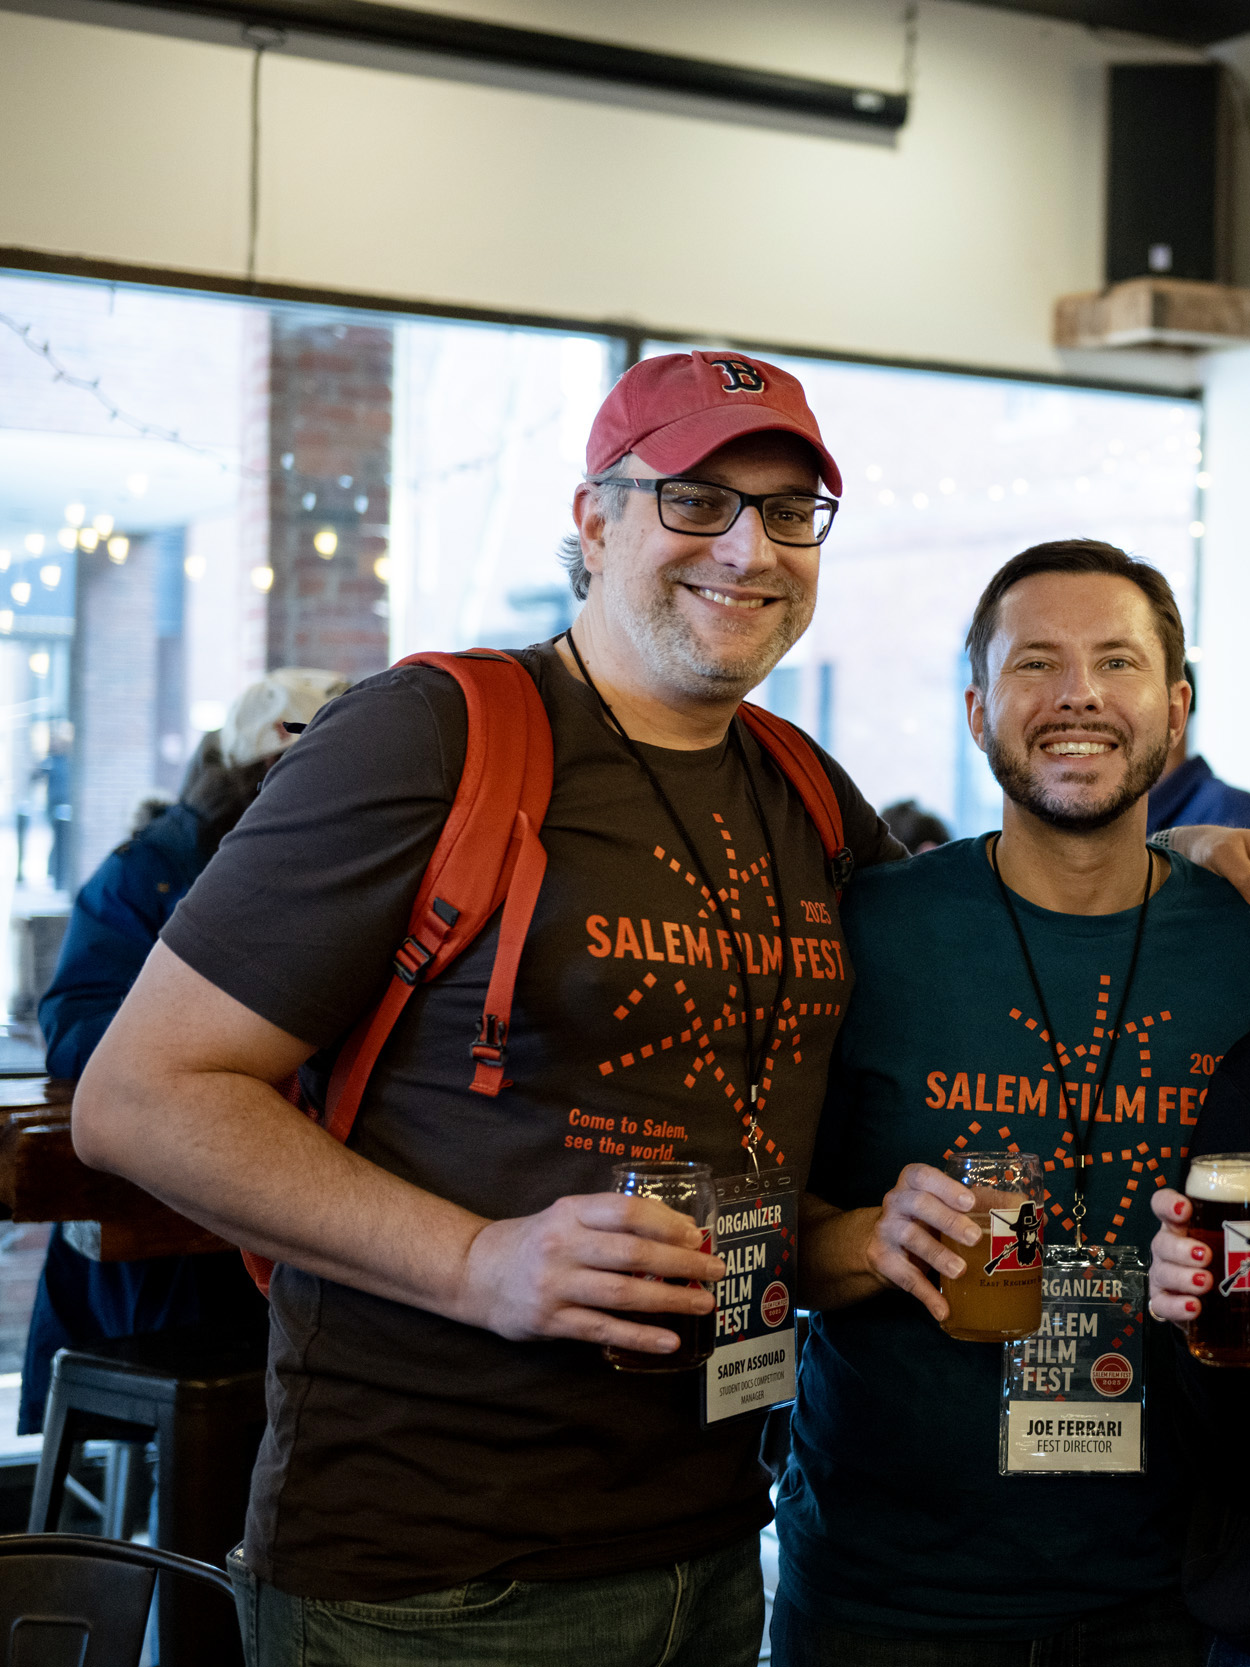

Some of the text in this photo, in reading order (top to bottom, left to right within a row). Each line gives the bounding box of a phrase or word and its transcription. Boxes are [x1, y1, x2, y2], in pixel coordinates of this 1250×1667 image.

[711, 359, 764, 393] B
[800, 900, 832, 925] 2025
[585, 914, 713, 969] SALEM
[790, 937, 845, 981] FEST
[1189, 1053, 1224, 1076] 20
[925, 1070, 1208, 1126] SALEM FILM FE
[568, 1108, 689, 1142] Come to Salem,
[564, 1134, 676, 1163] see the world.
[717, 1204, 782, 1236] ORGANIZER
[716, 1274, 752, 1308] FILM
[1041, 1278, 1123, 1298] RGANIZER
[716, 1303, 751, 1338] FEST
[1037, 1312, 1098, 1337] ALEM
[717, 1349, 786, 1380] SADRY ASSOUAD
[1024, 1339, 1077, 1364] FILM
[719, 1370, 785, 1397] STUDENT DOCS COMPETITION
[1022, 1367, 1075, 1392] FEST
[741, 1390, 765, 1405] MANAGER
[1027, 1420, 1122, 1437] JOE FERRARI
[1037, 1439, 1112, 1453] FEST DIRECTOR
